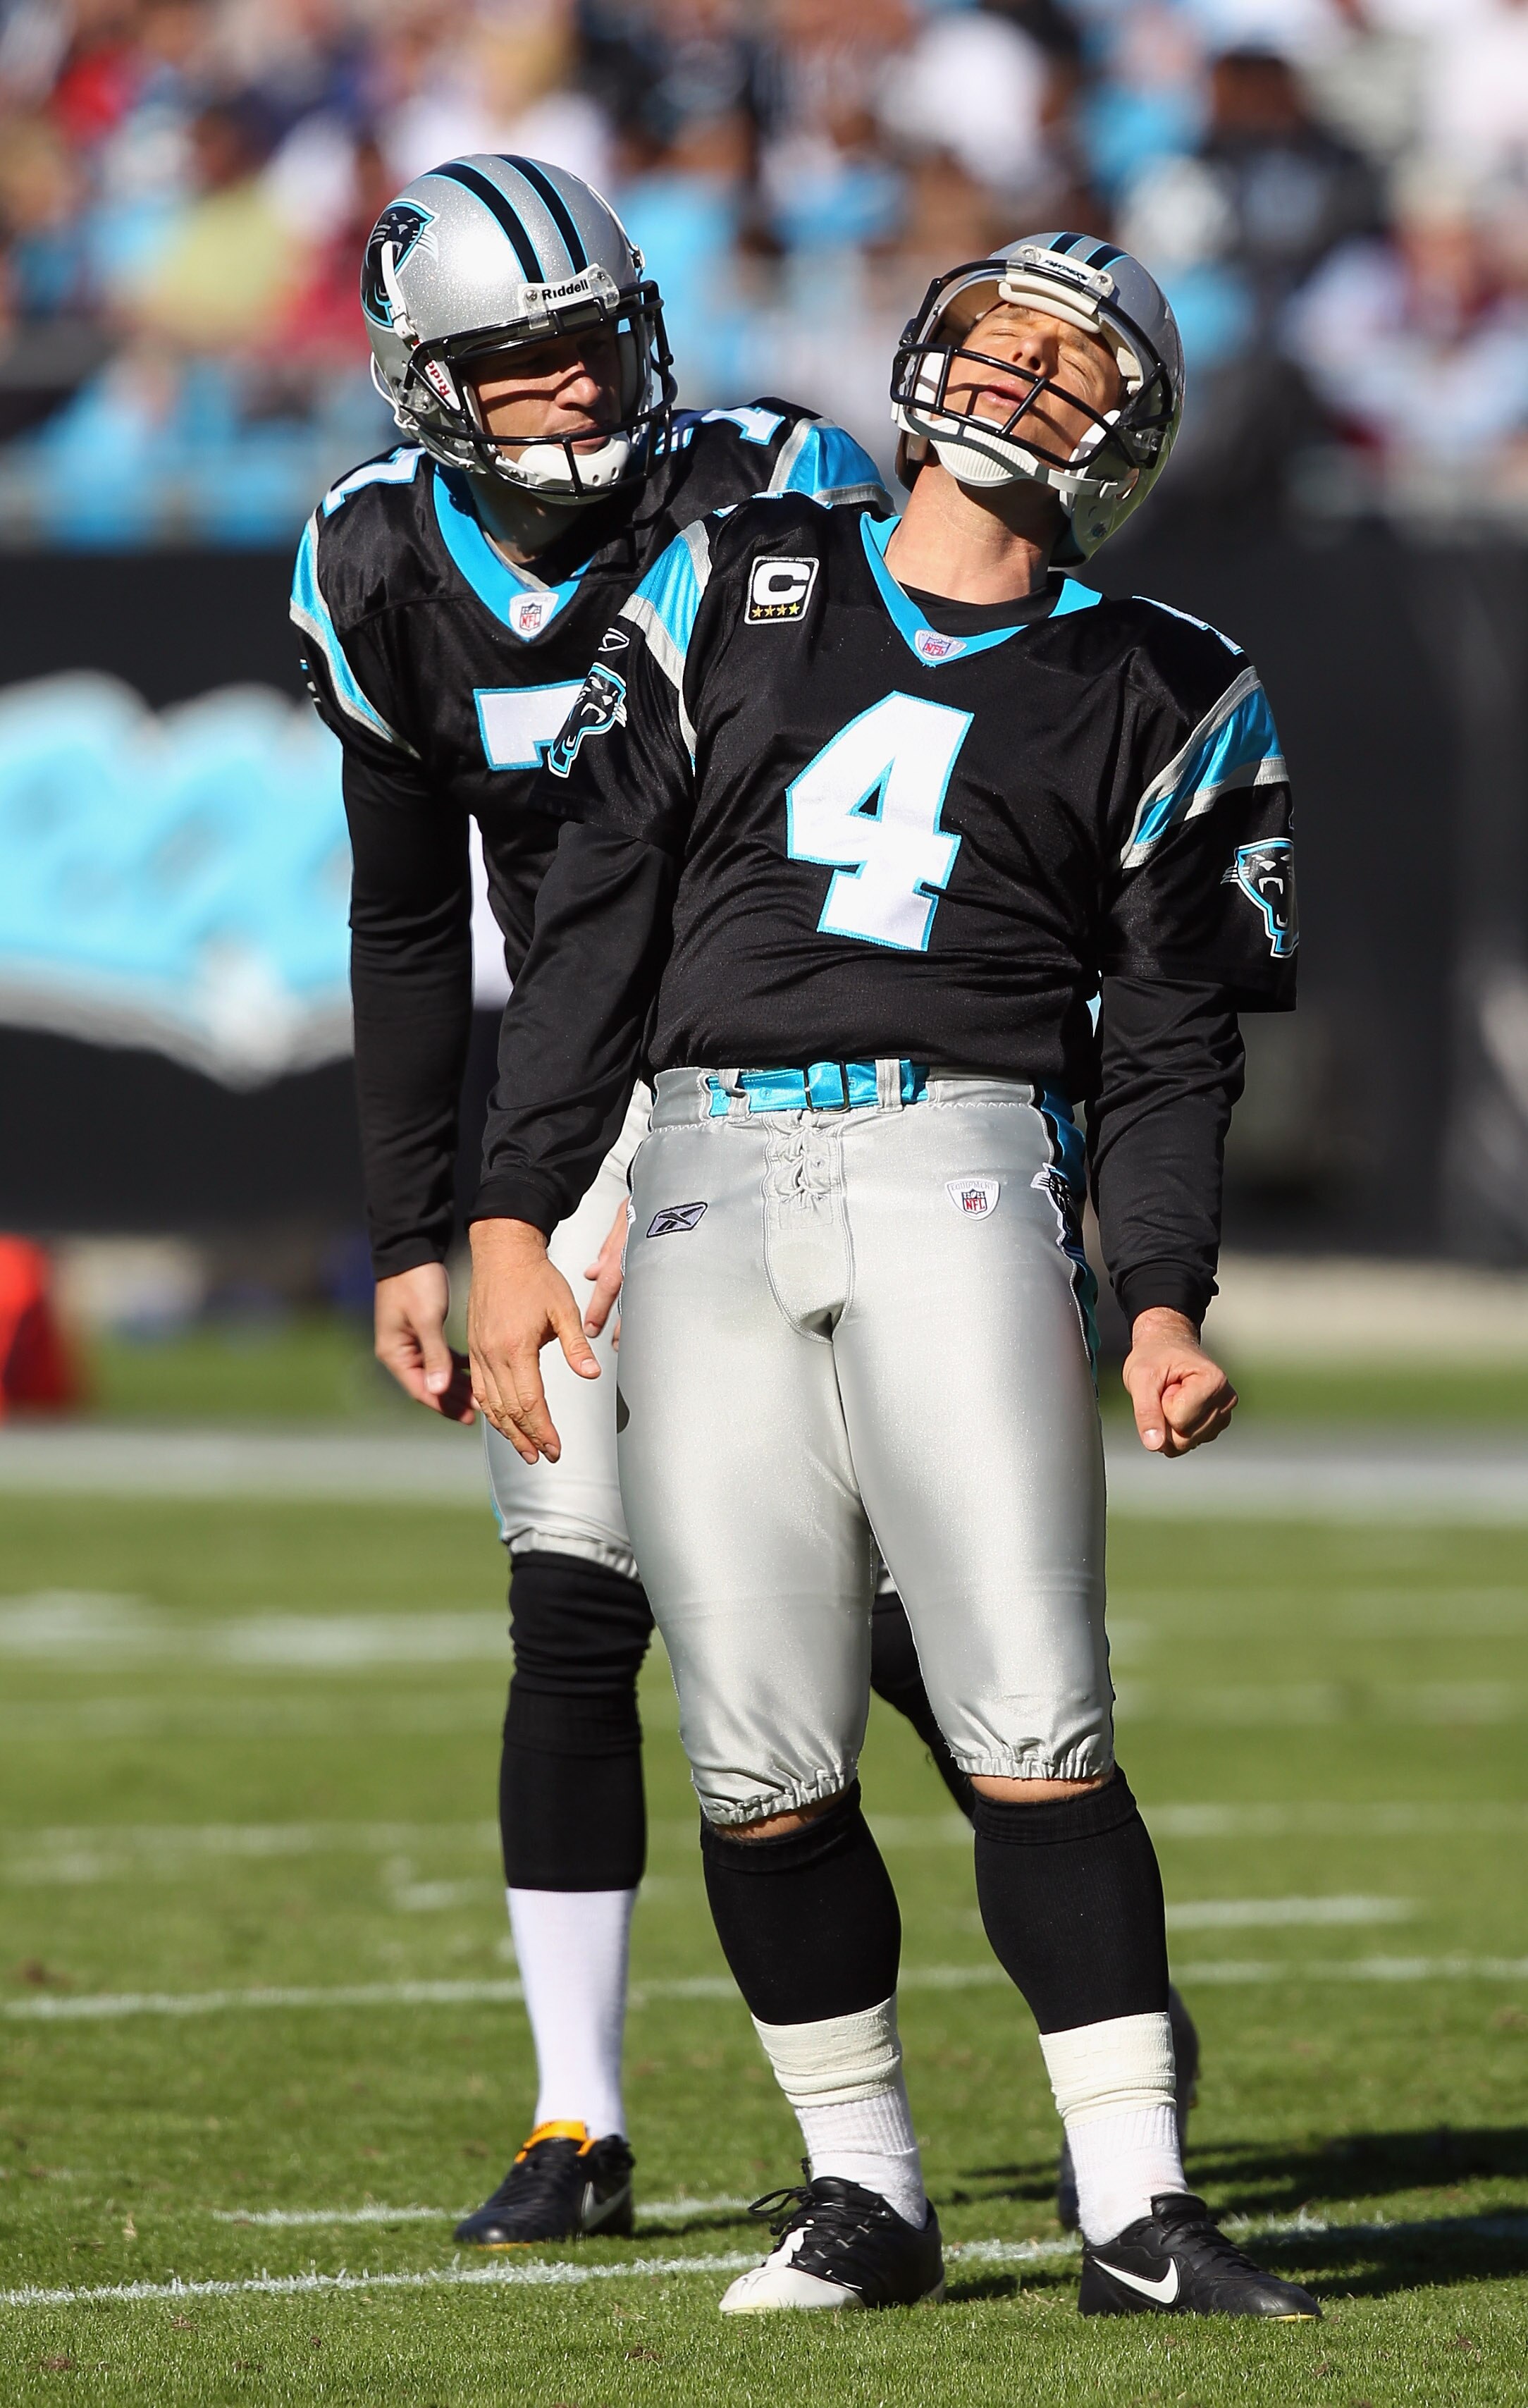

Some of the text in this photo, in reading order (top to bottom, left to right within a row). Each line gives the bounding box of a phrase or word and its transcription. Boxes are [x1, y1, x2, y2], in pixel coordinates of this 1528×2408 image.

[541, 279, 589, 300] Riddell
[753, 562, 811, 606] C
[785, 690, 975, 952] 4
[965, 1198, 986, 1211] NFL
